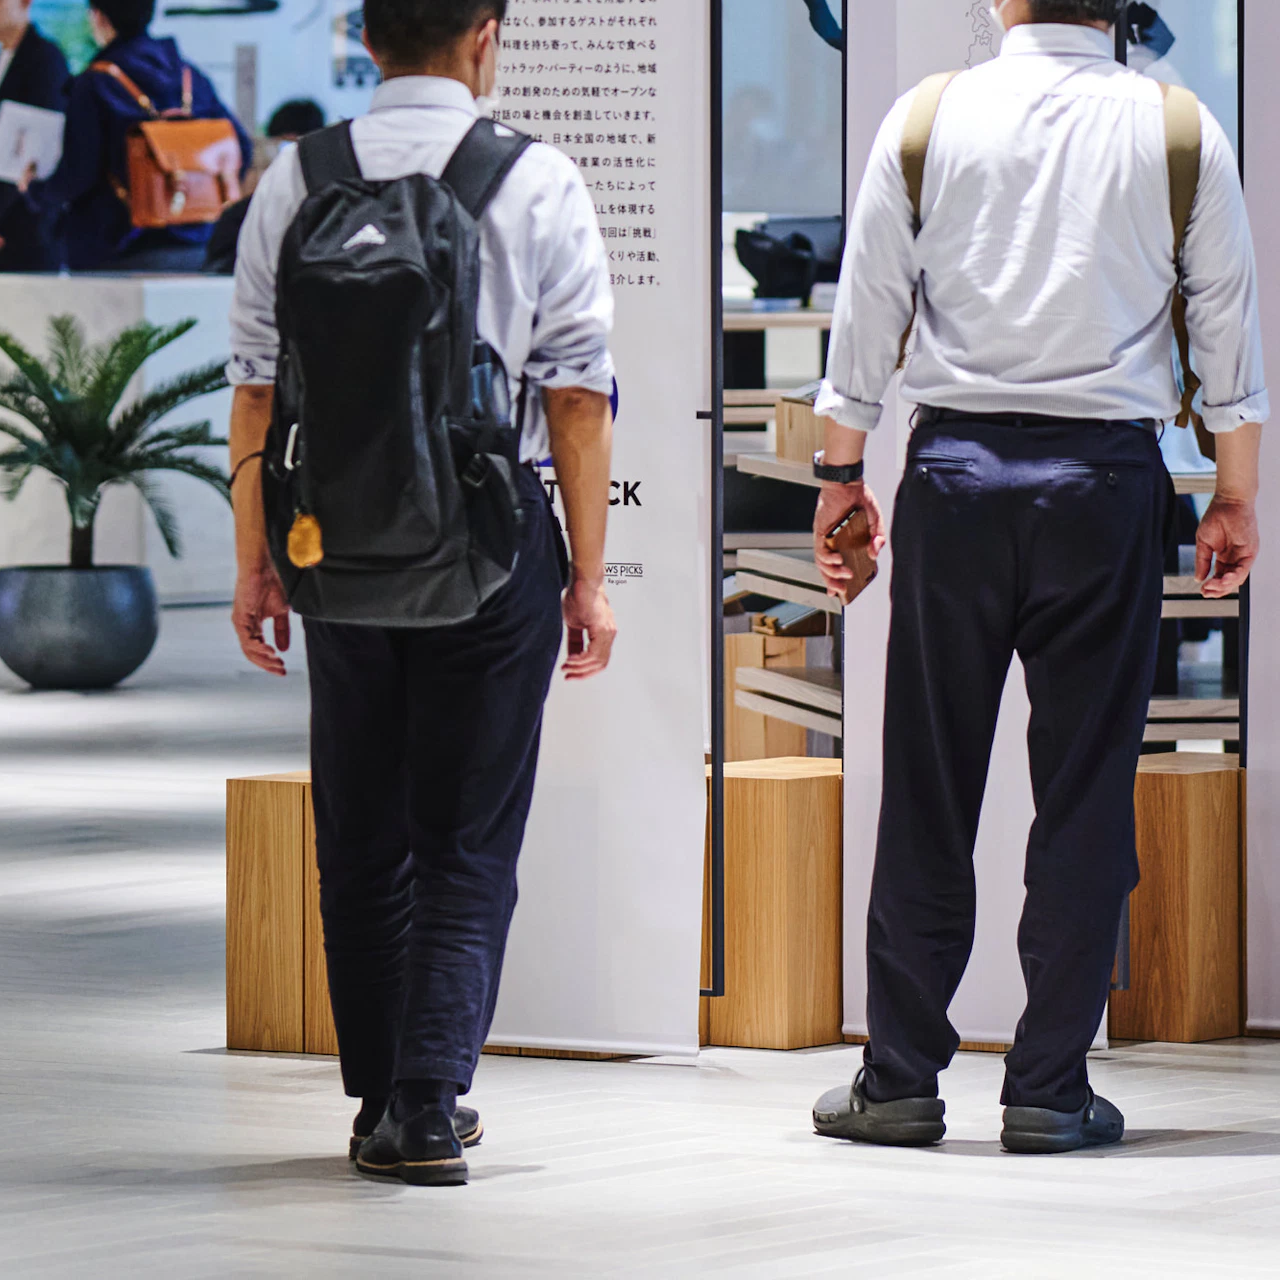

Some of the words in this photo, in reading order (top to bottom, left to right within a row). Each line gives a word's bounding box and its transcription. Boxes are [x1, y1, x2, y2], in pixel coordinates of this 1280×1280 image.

[498, 85, 657, 98] 済の創発のための気軽でオープンな
